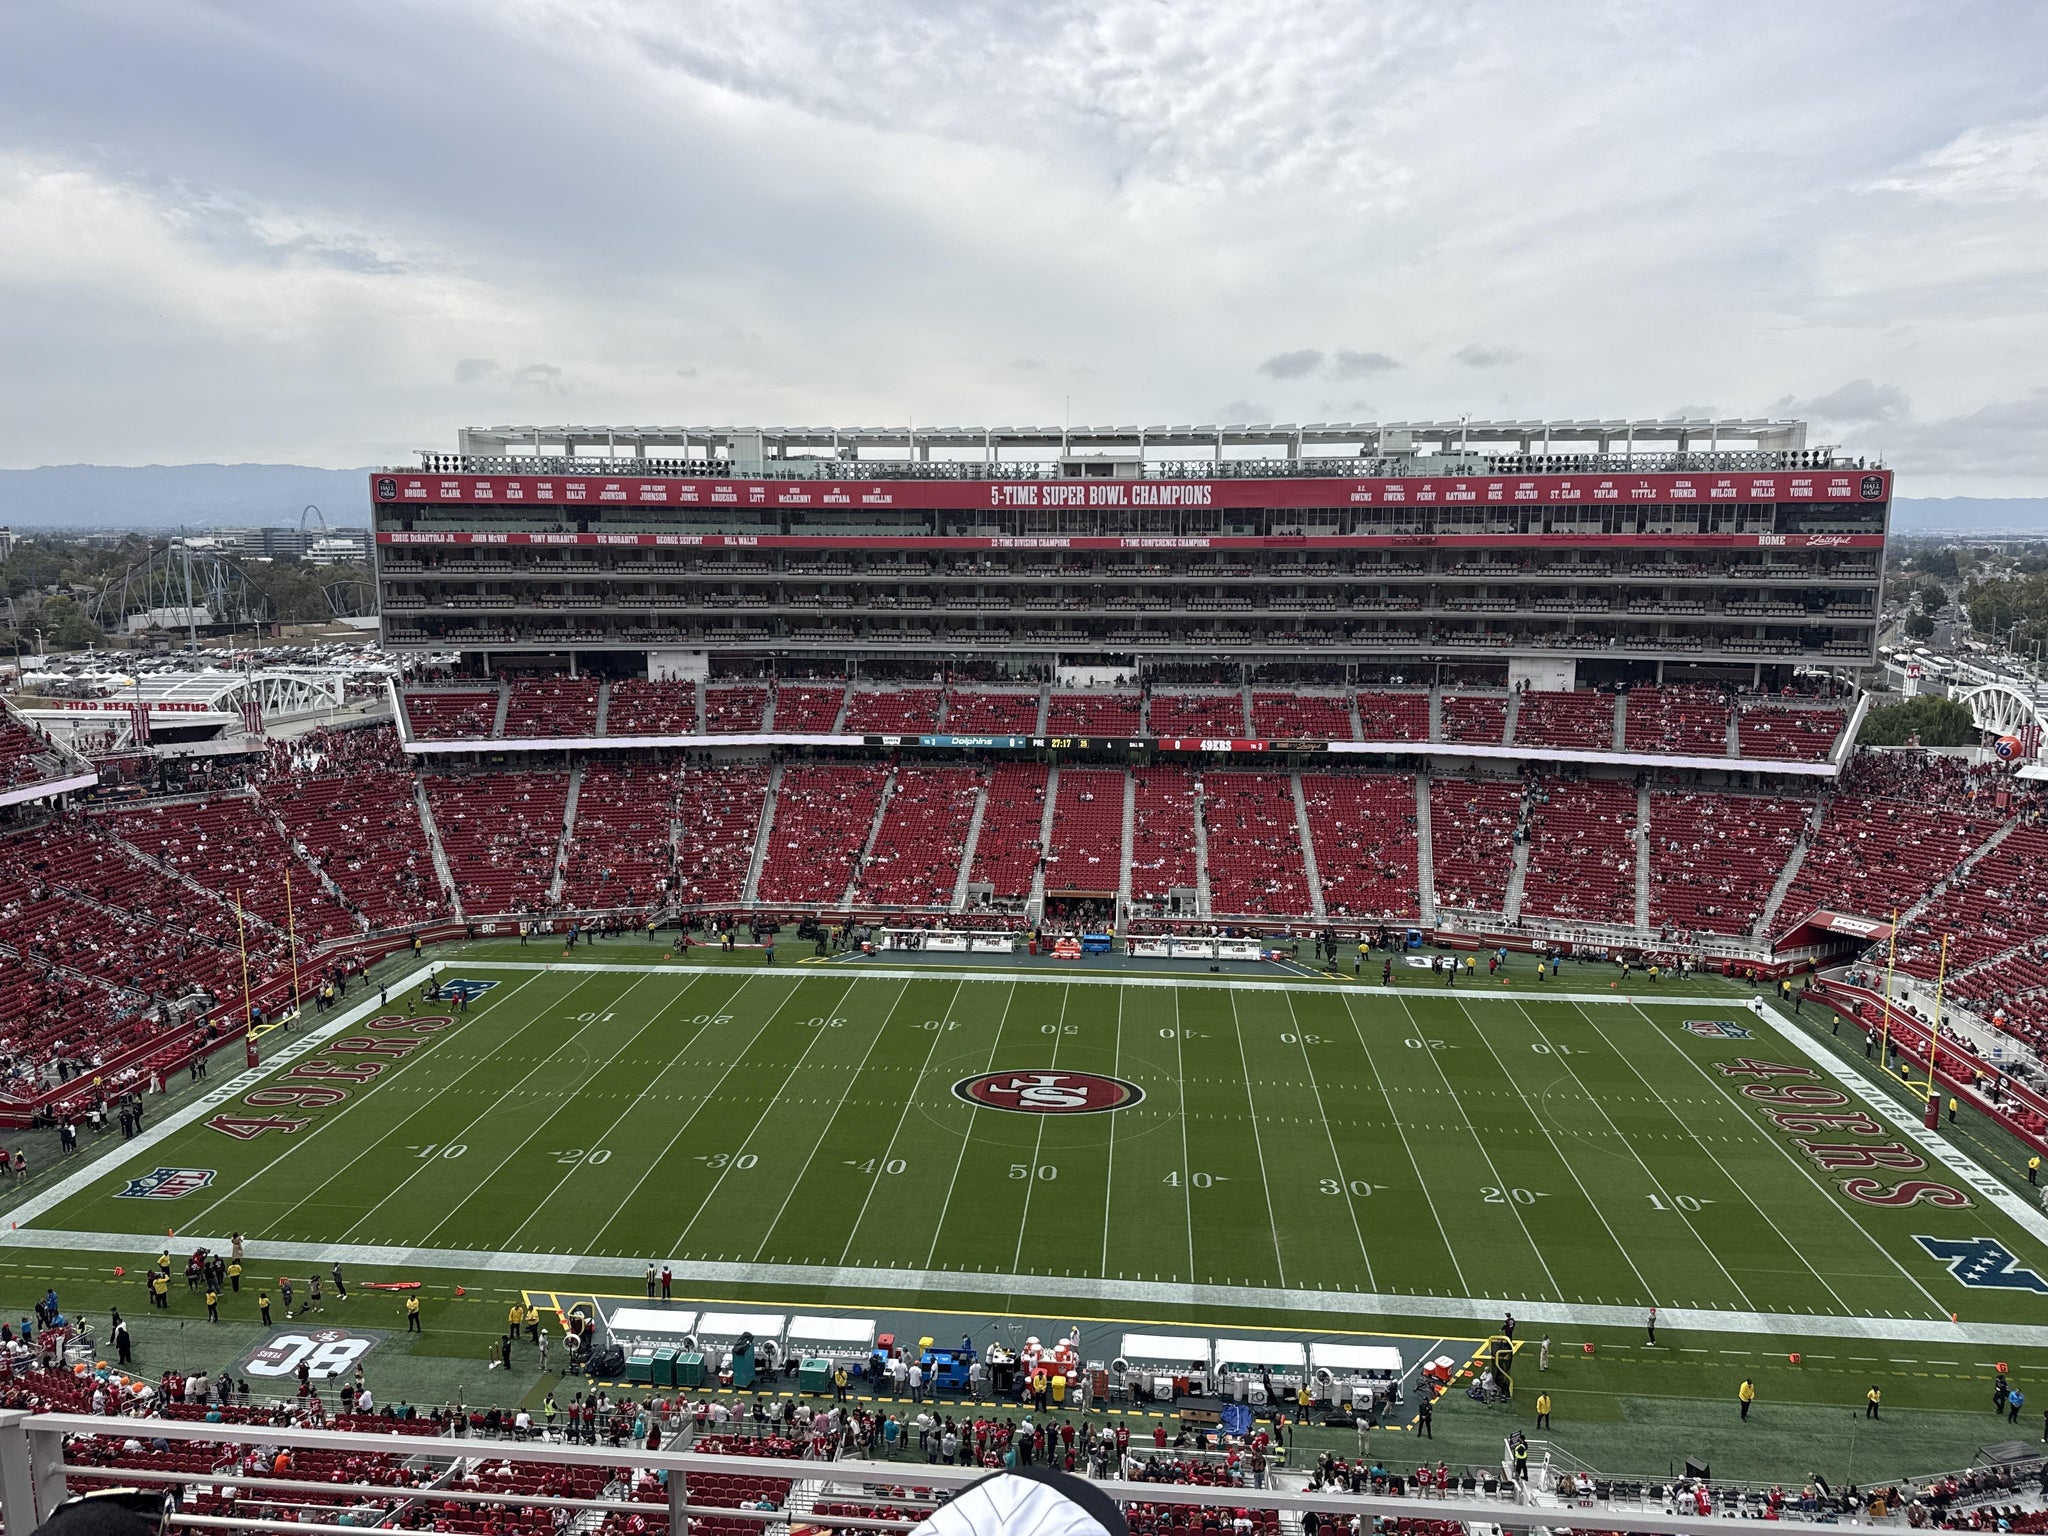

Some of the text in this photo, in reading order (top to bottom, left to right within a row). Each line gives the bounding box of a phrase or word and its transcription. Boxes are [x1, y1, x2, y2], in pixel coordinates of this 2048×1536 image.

[404, 489, 427, 498] BRODIE
[440, 489, 461, 498] CLARK
[475, 489, 493, 499] CRAIG
[507, 490, 523, 499] DEAN
[537, 490, 553, 499] GORE
[566, 491, 586, 500] HALEY
[599, 491, 627, 500] JOHNSON
[991, 485, 1211, 505] 5-TIME SUPER BOWL CHAMPIONS
[1445, 491, 1476, 500] RATHMAN
[1488, 491, 1502, 500] RICE
[1514, 490, 1538, 499] SOLTAU
[1550, 490, 1581, 499] ST. CLAIR
[1593, 489, 1618, 499] TAYLOR
[1631, 489, 1656, 498] TITTLE
[1670, 488, 1697, 498] TURNER
[1710, 488, 1737, 497] WILCOX
[1751, 488, 1775, 497] WILLIS
[1789, 487, 1813, 497] YOUNG
[1828, 487, 1851, 496] YOUNG
[639, 492, 667, 501] JOHNSON
[680, 493, 699, 502] JONES
[712, 493, 737, 502] KRUEGER
[750, 494, 765, 503] LOTT
[779, 494, 811, 503] McELHENNY
[824, 495, 850, 503] MONTANA
[862, 495, 892, 503] NOMELLINI
[1350, 492, 1372, 501] OWENS
[1383, 492, 1405, 501] OWENS
[1417, 492, 1436, 501] PERRY
[391, 534, 409, 542] EDDIE
[471, 534, 508, 543] JOHN McVAY
[529, 535, 578, 543] TONY MORABITO
[597, 535, 638, 544] VIC MORABITO
[656, 536, 703, 545] GEORGE SEIFERT
[724, 536, 758, 545] BILL WALSH
[1014, 538, 1037, 547] DIVISION
[1038, 538, 1070, 547] CHAMPIONS
[1759, 536, 1786, 545] HOME
[1141, 539, 1177, 547] CONFERENCE
[1178, 539, 1210, 547] CHAMPIONS
[951, 737, 992, 746] Dolphins
[1033, 739, 1045, 747] PRE
[1051, 739, 1071, 748] 27:17
[1175, 741, 1180, 749] 0
[1200, 740, 1232, 751] 49ERS
[1994, 743, 2014, 758] 76
[576, 1012, 617, 1024] 10
[692, 1014, 734, 1026] 20
[808, 1016, 847, 1029] 30
[924, 1020, 962, 1032] 40
[1041, 1024, 1079, 1034] 50
[1159, 1027, 1197, 1040] 40
[1281, 1032, 1321, 1045] 30
[1404, 1037, 1449, 1050] 20
[1531, 1043, 1577, 1055] 10
[202, 1034, 328, 1103] CHOOSE LOVE
[203, 1014, 458, 1141] 49ERS
[1709, 1056, 1978, 1209] 49ERS
[1834, 1071, 2010, 1197] IT TAKES ALL OF US
[413, 1143, 468, 1159] 10
[557, 1149, 613, 1165] 20
[706, 1153, 760, 1170] 30
[857, 1158, 907, 1175] 40
[1008, 1164, 1058, 1181] 50
[1162, 1170, 1213, 1189] 40
[1319, 1178, 1373, 1198] 30
[1479, 1186, 1537, 1205] 20
[1645, 1193, 1703, 1212] 10
[257, 1350, 282, 1359] YEARS
